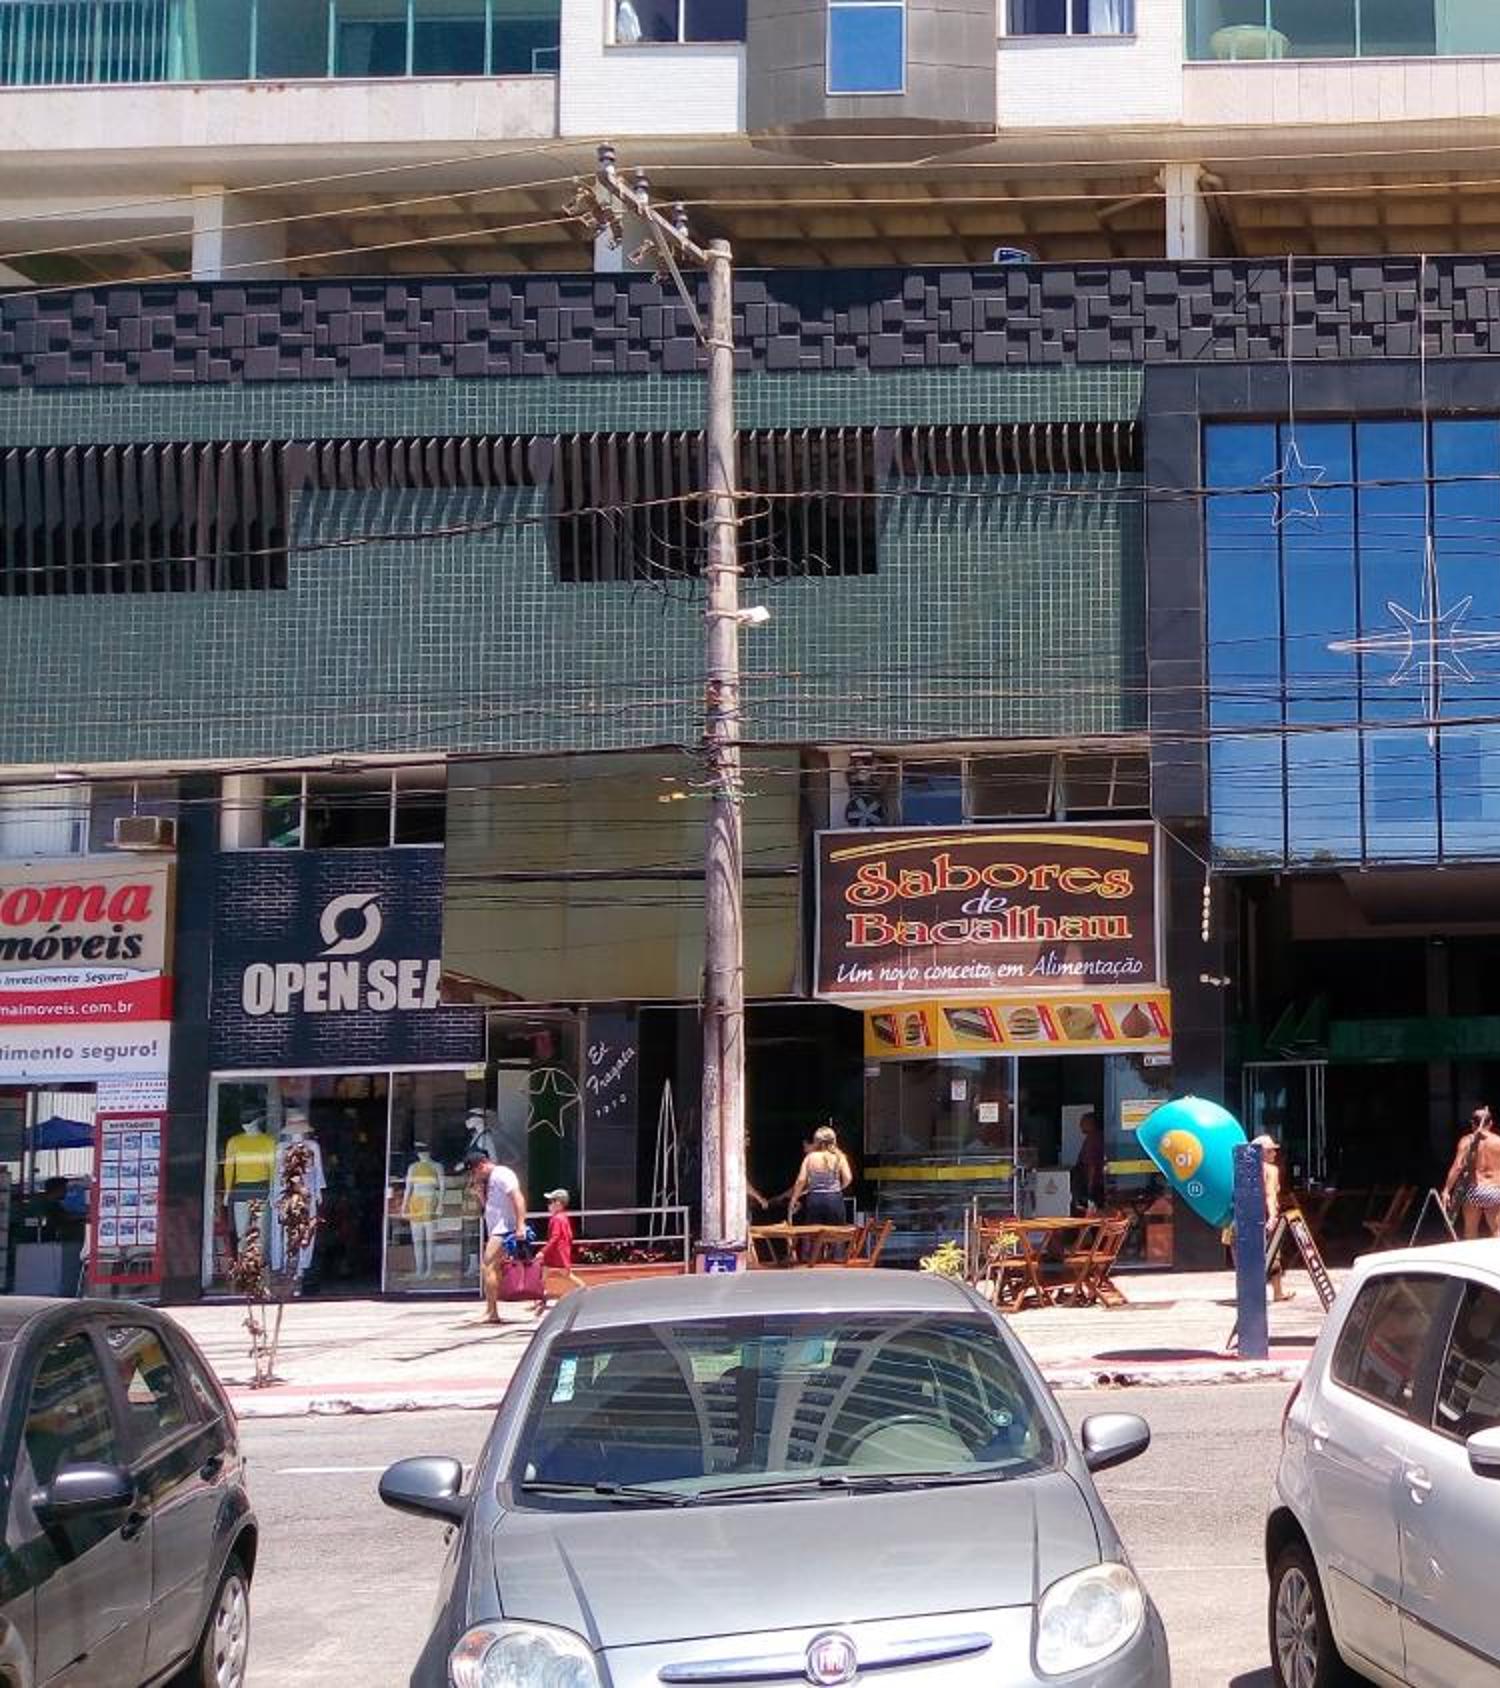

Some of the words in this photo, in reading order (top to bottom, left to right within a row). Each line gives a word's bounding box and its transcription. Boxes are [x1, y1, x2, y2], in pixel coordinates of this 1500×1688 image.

[845, 853, 1134, 906] Sabores
[1, 883, 153, 926] oma
[961, 888, 1006, 914] de
[0, 924, 143, 961] móveis
[846, 906, 1132, 947] Bacalhau
[837, 961, 872, 983] Um
[880, 966, 918, 983] novo
[923, 961, 991, 981] conceito
[997, 964, 1024, 977] em
[1029, 950, 1143, 977] Alimentação
[242, 961, 360, 1016] OPEN
[0, 1001, 134, 1017] maimoveis.com.br
[0, 1044, 74, 1061] imento
[80, 1040, 158, 1062] seguro!
